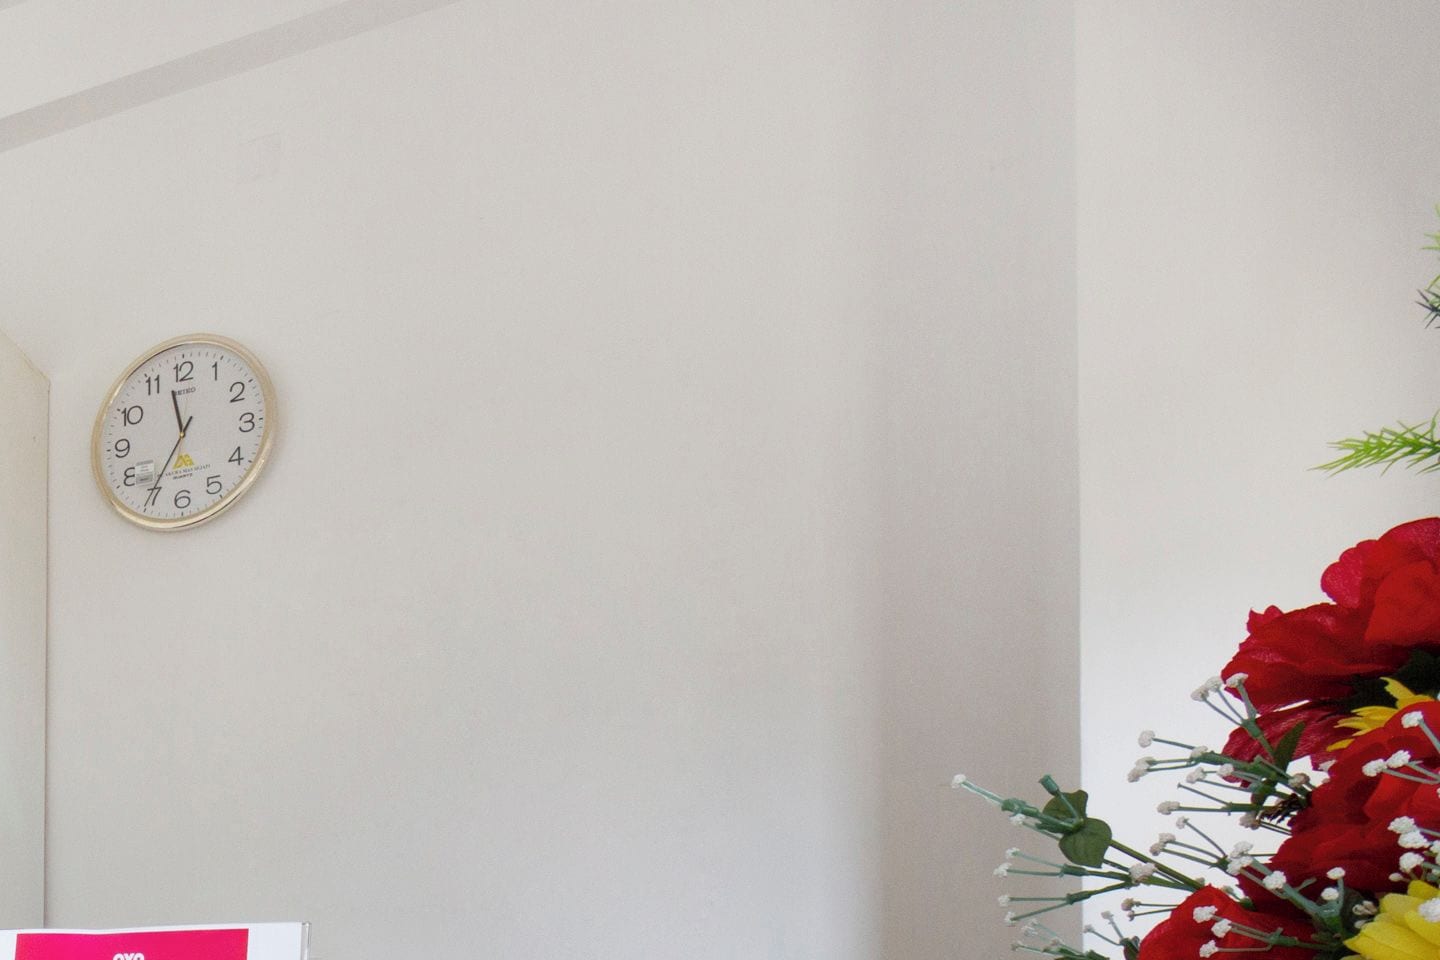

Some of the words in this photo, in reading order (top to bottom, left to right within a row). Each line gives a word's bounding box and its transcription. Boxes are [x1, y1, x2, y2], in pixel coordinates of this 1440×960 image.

[173, 361, 194, 382] 12
[212, 362, 218, 381] 1
[146, 374, 160, 396] 11
[230, 382, 245, 403] 2
[122, 406, 144, 426] 10
[239, 412, 255, 432] 3
[115, 438, 130, 458] 9
[228, 446, 244, 466] 4
[206, 475, 223, 494] 5
[147, 486, 162, 506] 7
[174, 490, 192, 509] 6
